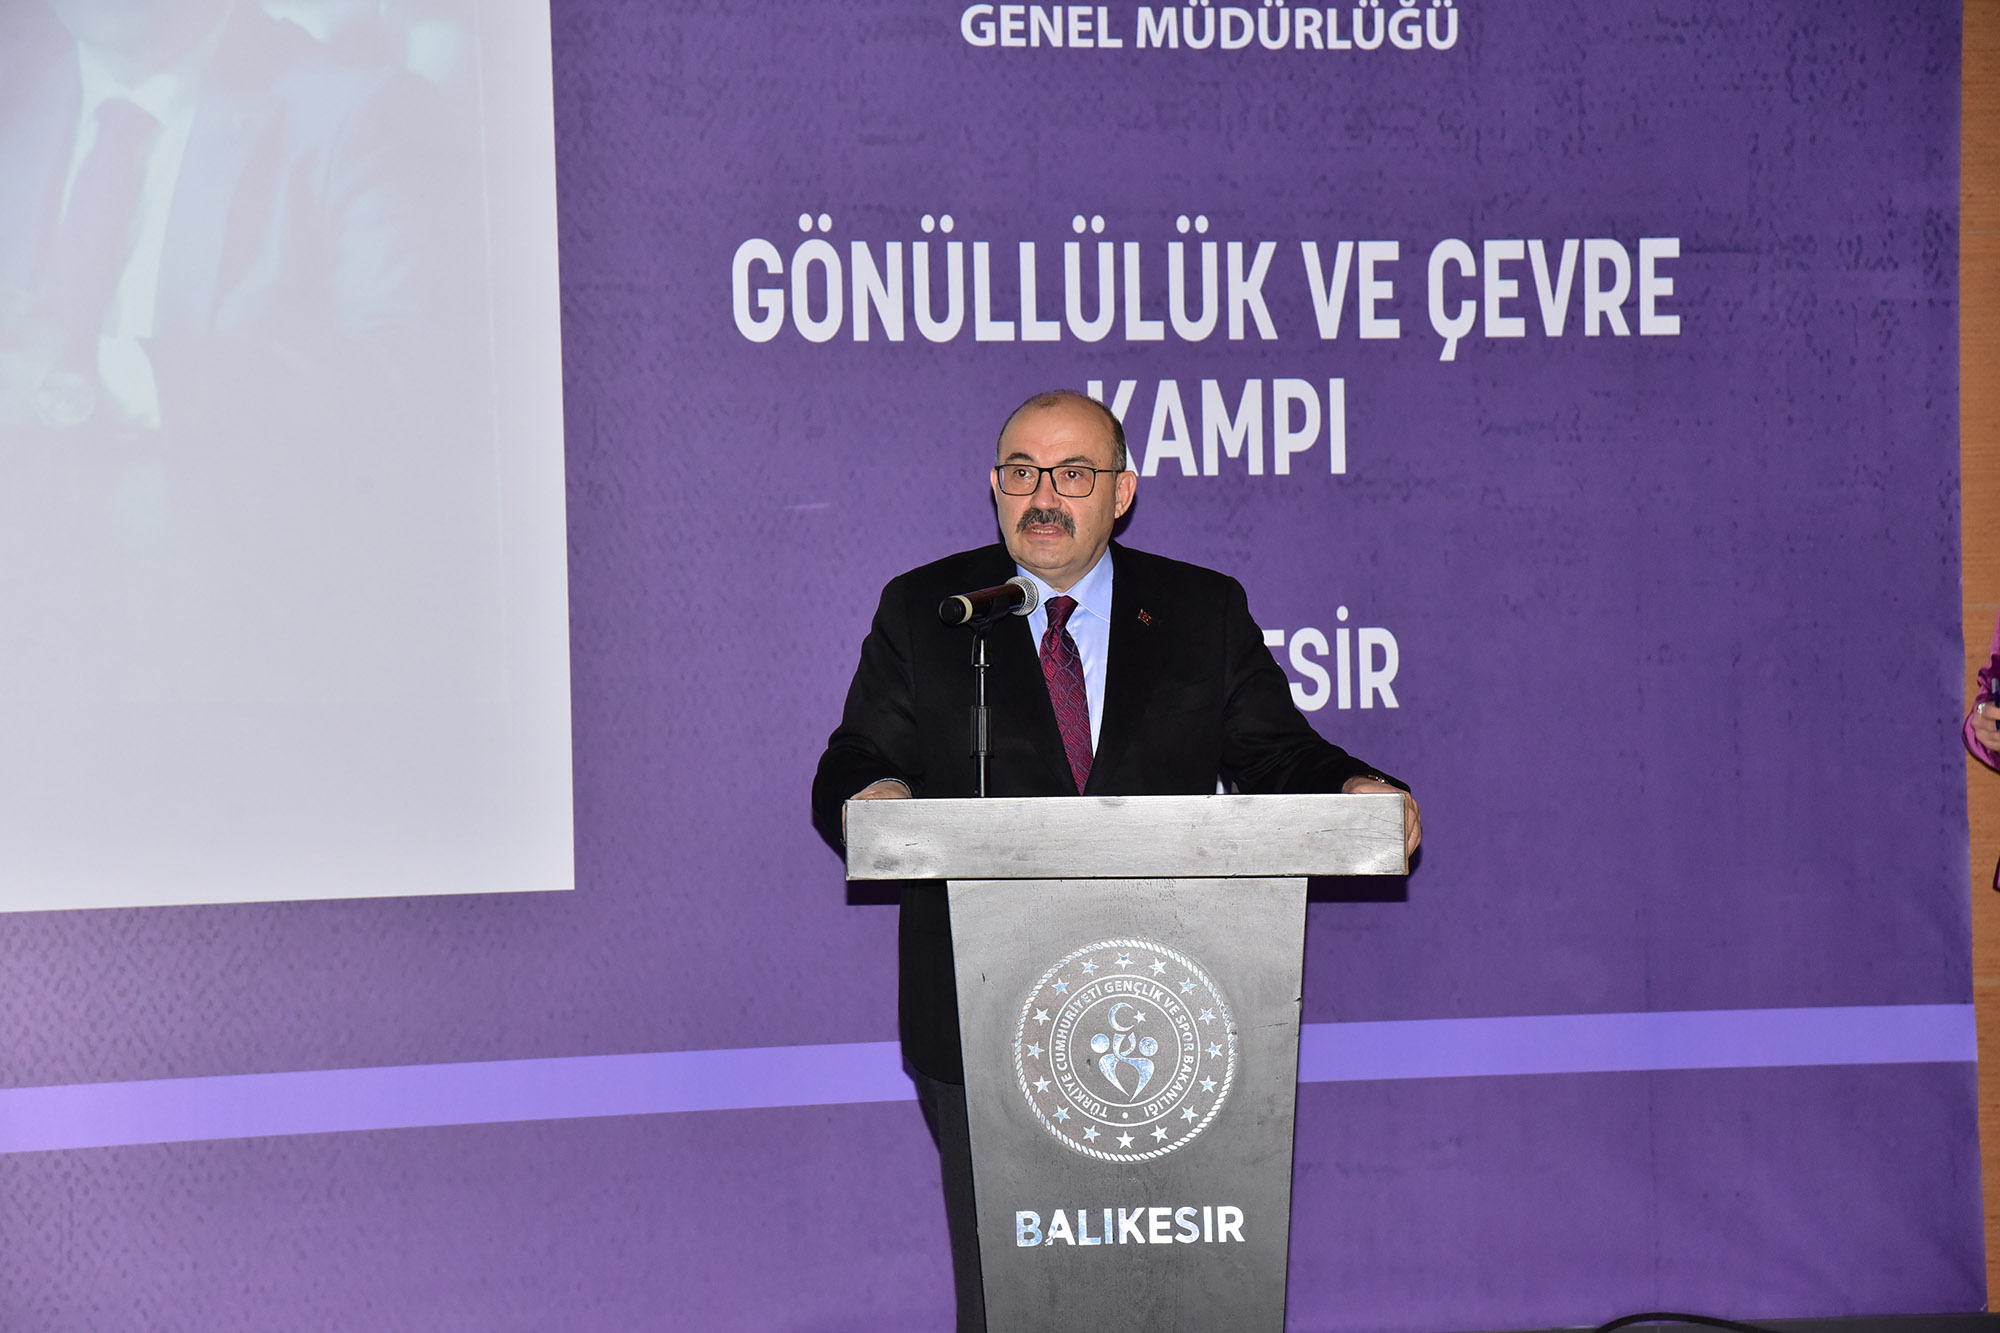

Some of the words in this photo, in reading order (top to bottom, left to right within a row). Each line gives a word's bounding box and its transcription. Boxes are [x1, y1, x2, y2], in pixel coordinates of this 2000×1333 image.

[960, 4, 1123, 48] GENEL
[1136, 0, 1458, 50] MÜDÜRLÜĞÜ
[731, 213, 1278, 343] GÖNÜLLÜLÜK
[1301, 241, 1400, 340] VE
[1427, 237, 1681, 361] ÇEVRE
[1262, 605, 1400, 712] SİR
[1104, 980, 1164, 1002] GENÇLİK
[1163, 998, 1182, 1016] VE
[1175, 1014, 1195, 1052] SPOR
[1143, 1056, 1194, 1118] BAKANLIĞI
[1015, 1205, 1246, 1248] BALIKESIR
